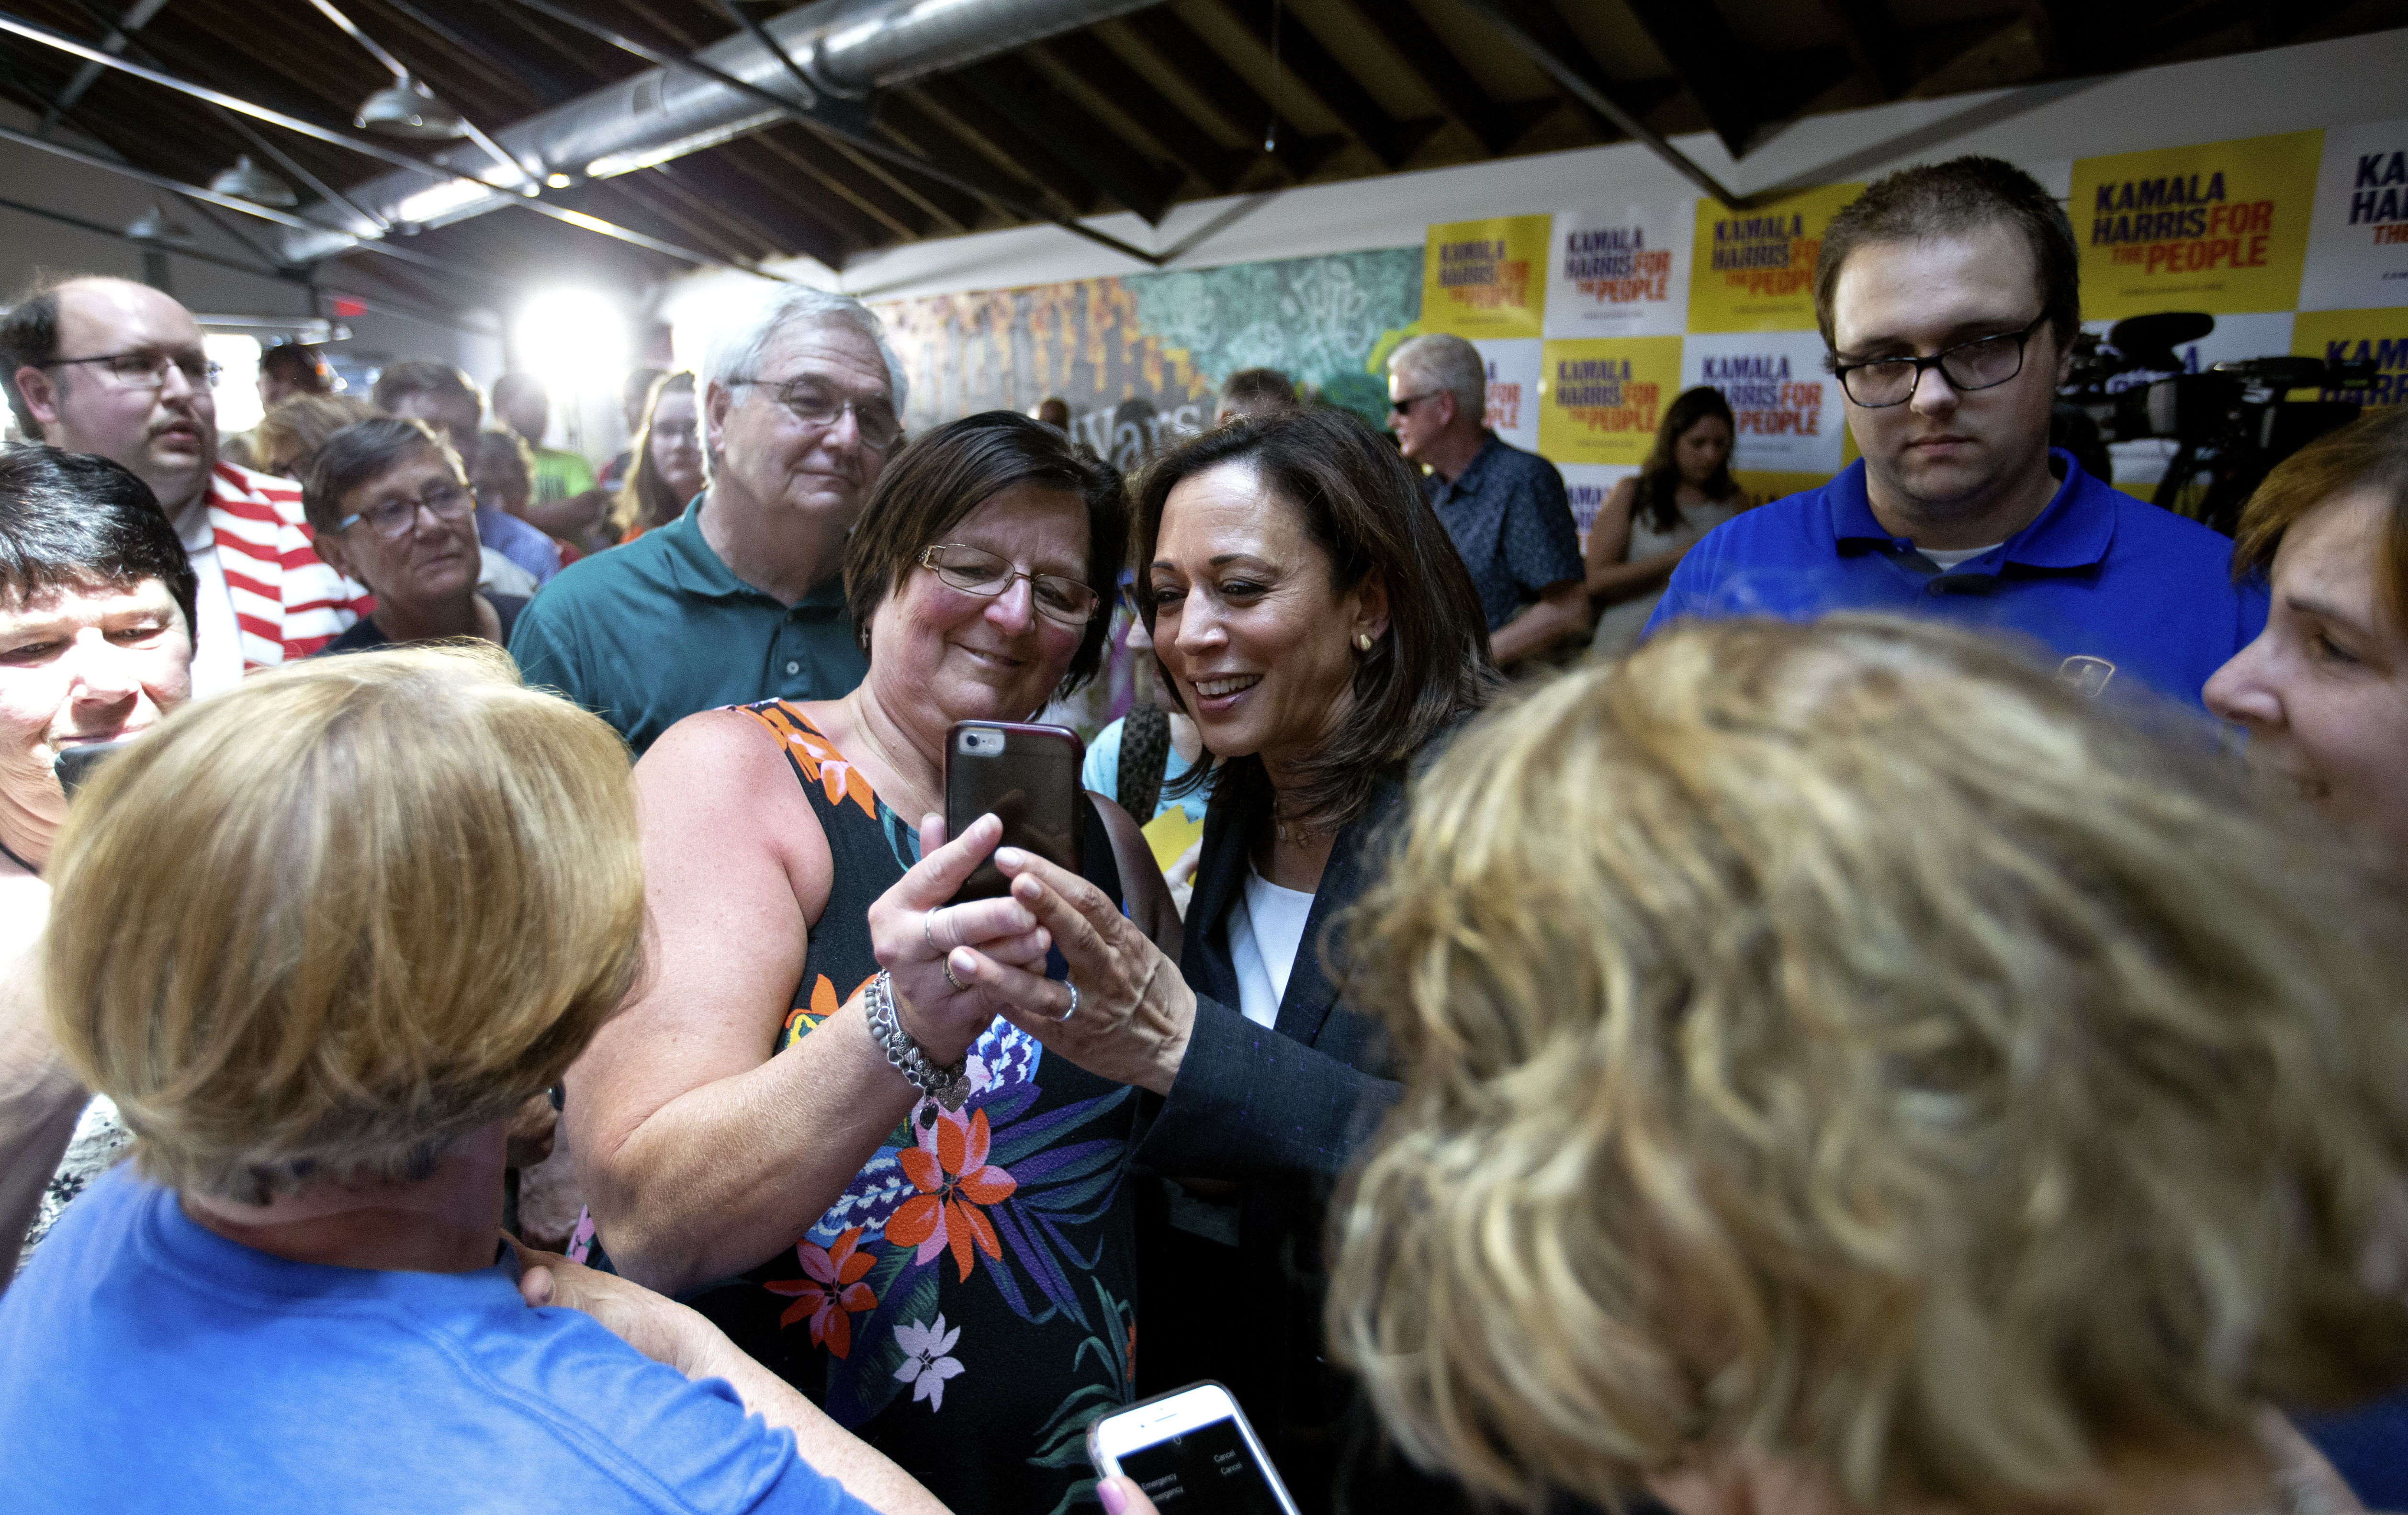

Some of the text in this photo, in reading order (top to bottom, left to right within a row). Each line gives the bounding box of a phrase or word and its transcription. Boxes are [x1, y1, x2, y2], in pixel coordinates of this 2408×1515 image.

[2095, 172, 2225, 211] KAMALA
[1714, 213, 1803, 240] KAMALA
[2092, 200, 2273, 246] HARRIS FOR
[1566, 227, 1643, 252] KAMALA
[1564, 249, 1671, 279] HARRIS FOR
[1712, 239, 1820, 271] HARRIS FO
[2145, 236, 2269, 275] PEOPLE
[1596, 277, 1668, 304] PEOPLE
[1748, 269, 1815, 297] PEOP
[1558, 359, 1632, 382] KAMALA
[1702, 356, 1791, 380] KAMALA
[1556, 383, 1660, 408] HARRIS FOR
[1716, 382, 1823, 407] RRIS FOR
[1587, 407, 1658, 433] PEOPLE
[1739, 410, 1821, 436] PEOPLE
[1214, 1449, 1236, 1462] Cancel
[1220, 1461, 1243, 1475] Cancel
[1141, 1472, 1177, 1492] Emergency
